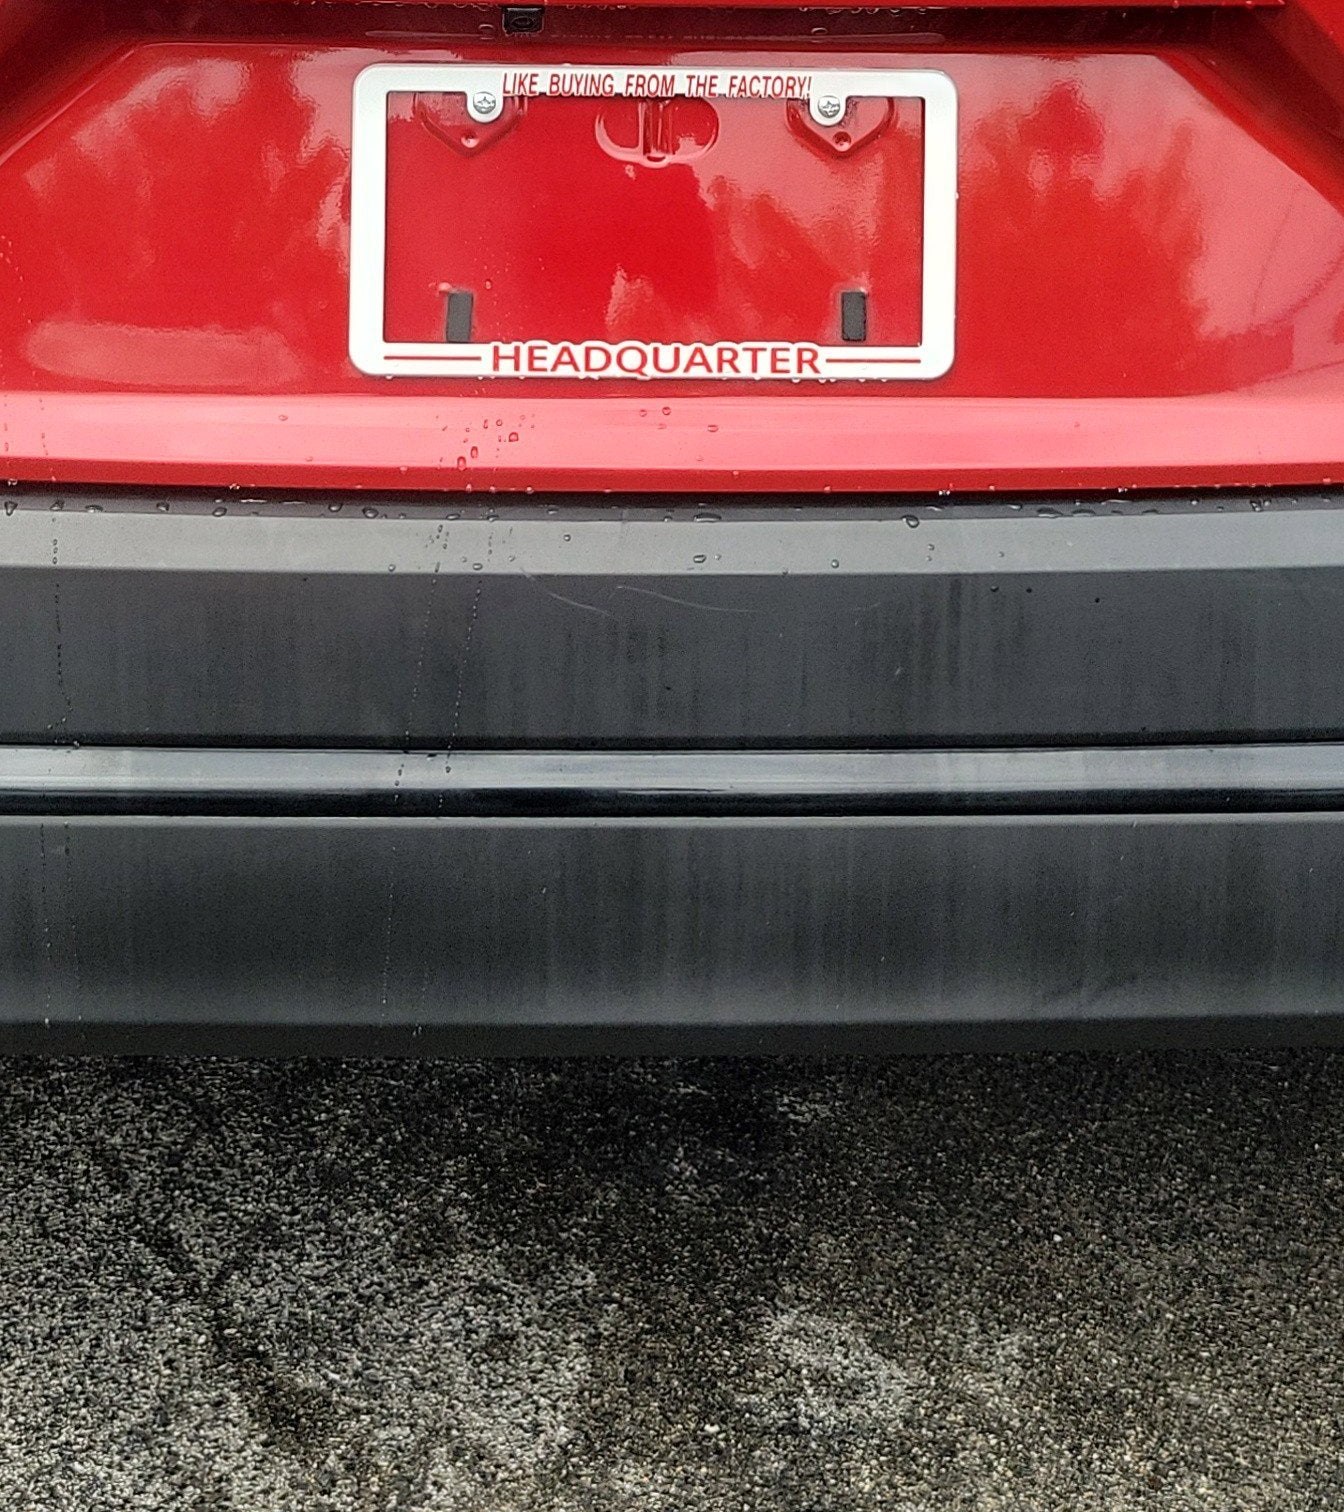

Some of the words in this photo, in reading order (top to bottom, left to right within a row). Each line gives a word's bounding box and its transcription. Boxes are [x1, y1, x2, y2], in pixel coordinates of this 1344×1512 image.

[502, 72, 539, 96] LIKE
[548, 73, 615, 96] BUYING
[624, 74, 677, 97] FROM
[686, 74, 719, 97] THE
[725, 75, 813, 98] FACTORY!
[492, 344, 821, 376] HEADQUARTER
